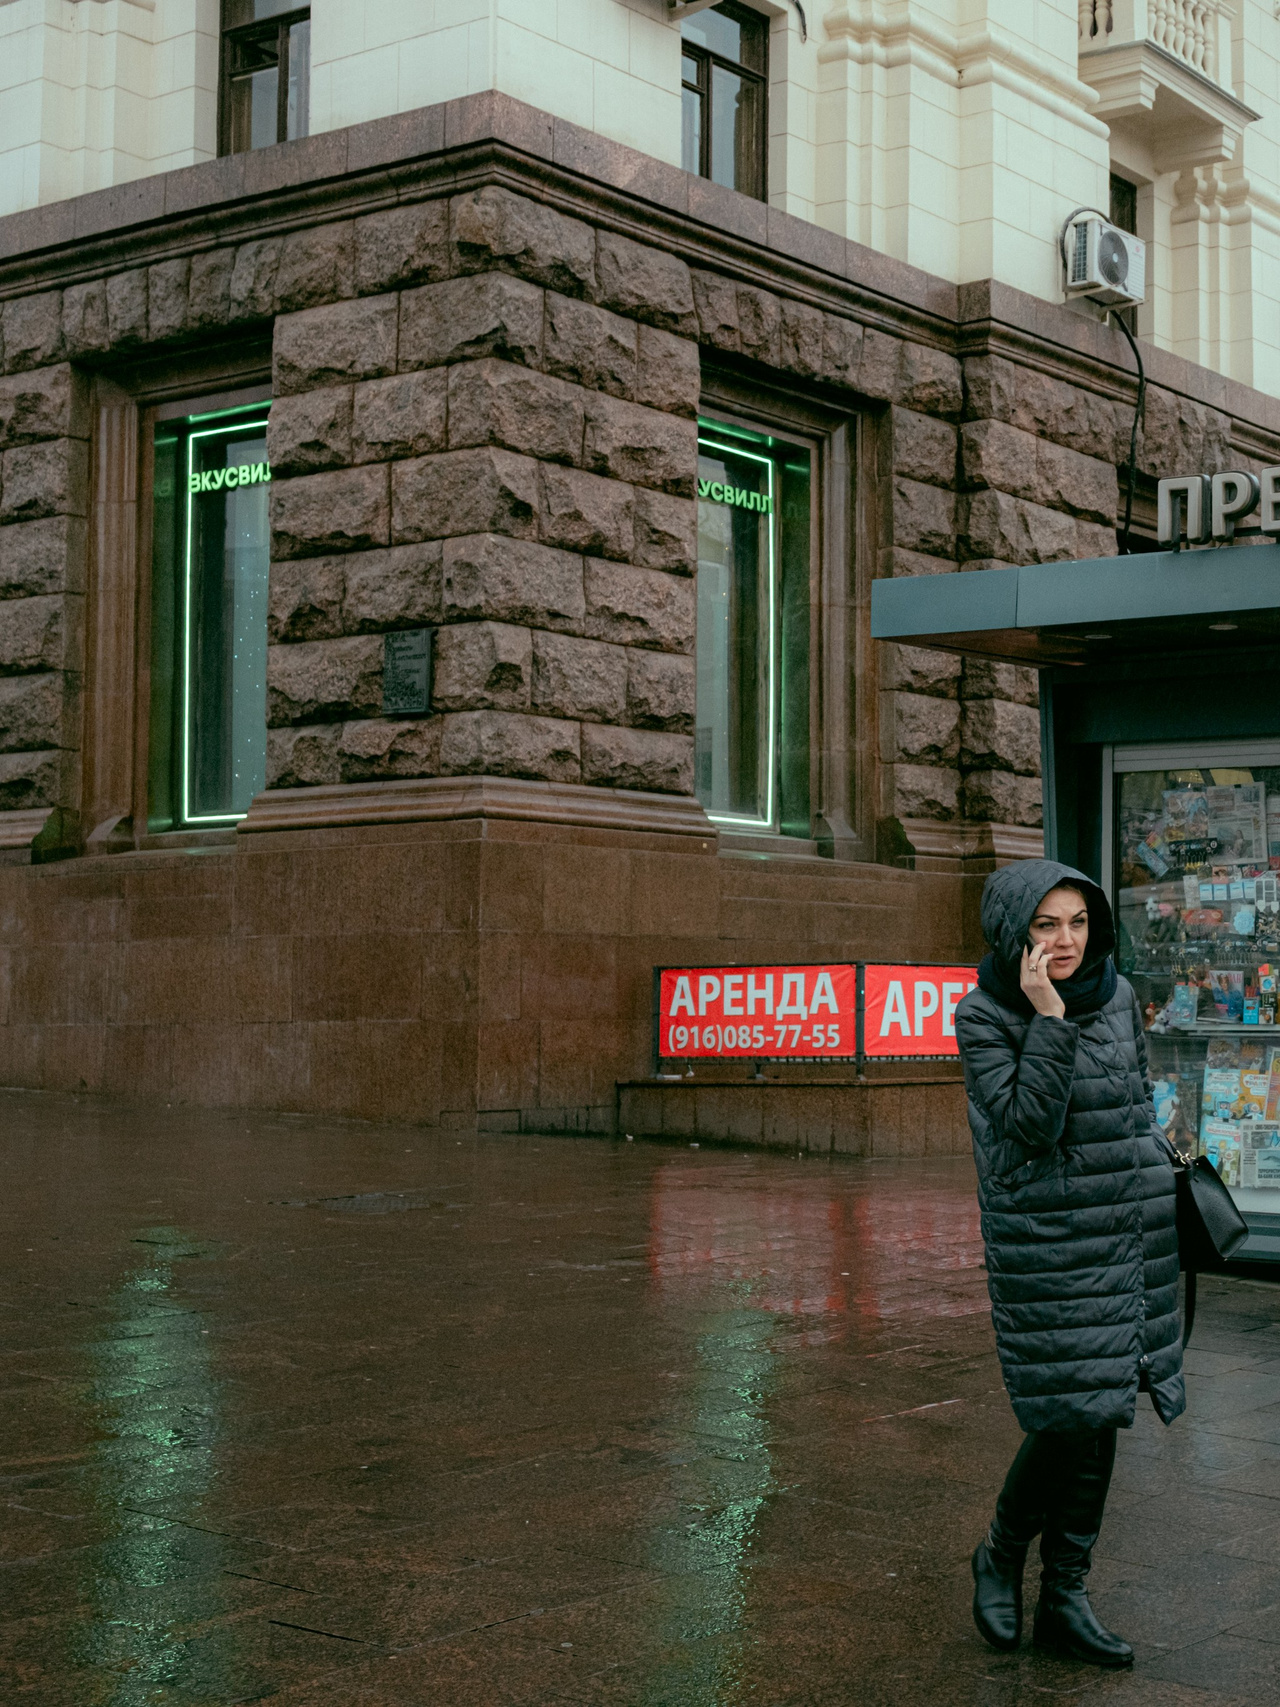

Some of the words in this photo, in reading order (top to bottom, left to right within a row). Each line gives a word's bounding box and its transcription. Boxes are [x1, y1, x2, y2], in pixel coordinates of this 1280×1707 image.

[697, 478, 773, 513] УСВИЛЛ
[669, 972, 839, 1020] АРЕНДА
[879, 980, 976, 1037] АРЕ
[668, 1023, 841, 1052] (916)085-77-55
